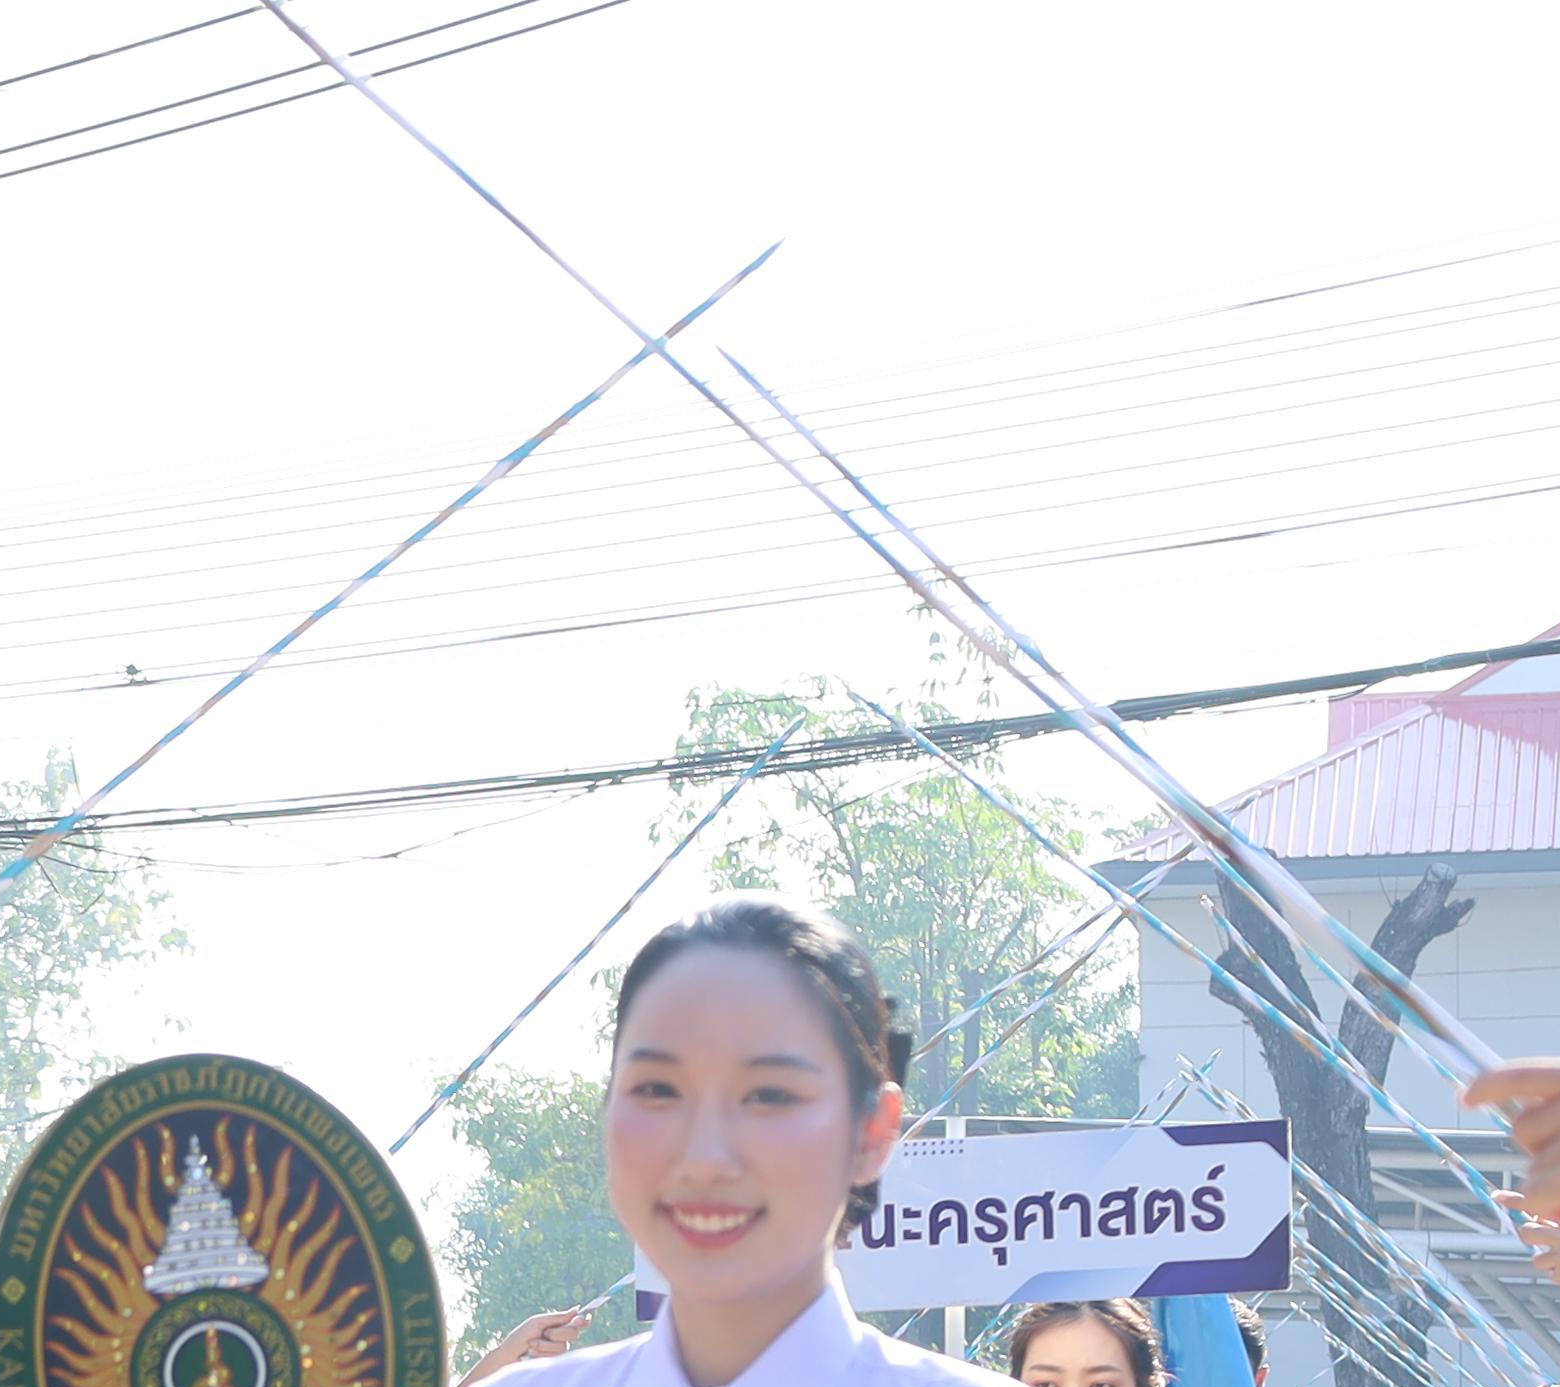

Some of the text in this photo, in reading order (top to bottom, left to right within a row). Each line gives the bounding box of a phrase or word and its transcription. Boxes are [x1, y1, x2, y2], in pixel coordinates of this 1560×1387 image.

[836, 1164, 1226, 1266] ณะครุศาสตร์
